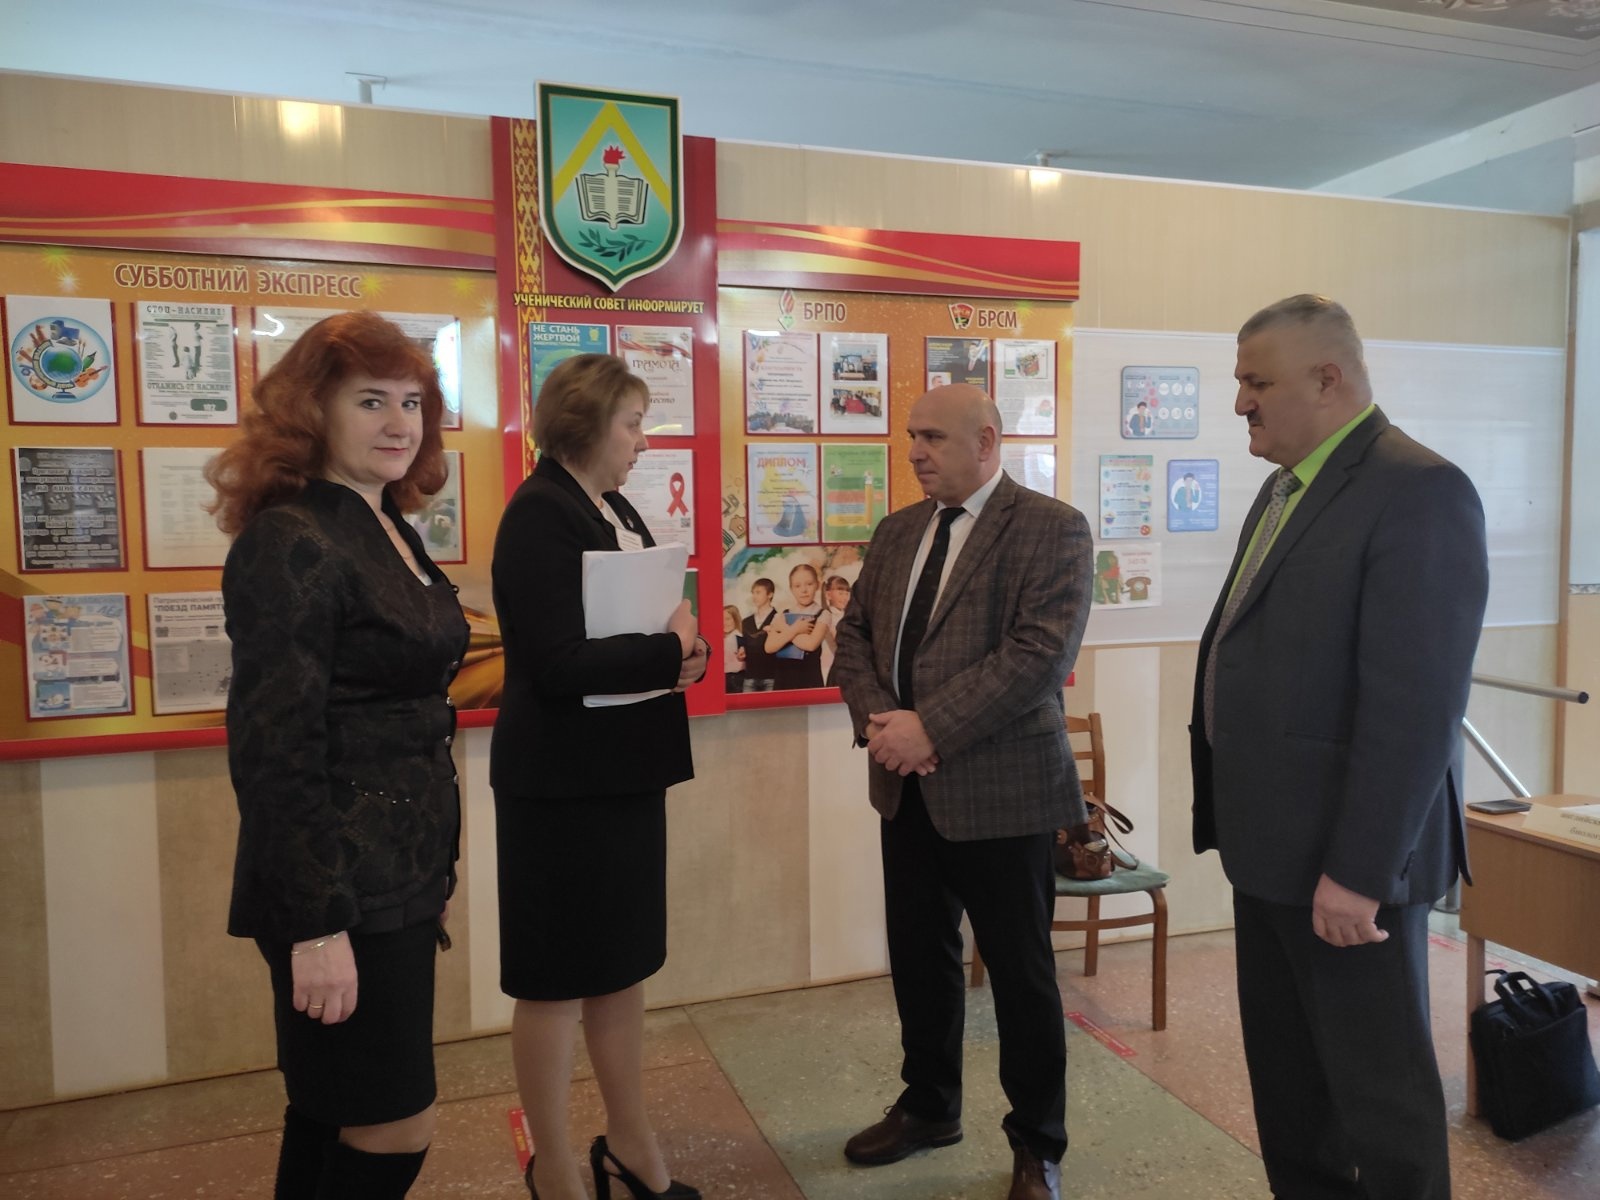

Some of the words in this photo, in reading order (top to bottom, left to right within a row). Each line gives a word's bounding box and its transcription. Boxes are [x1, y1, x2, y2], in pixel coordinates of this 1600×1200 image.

[115, 264, 249, 292] СУББОТНИЙ
[258, 271, 361, 297] ЭКСПРЕСС
[514, 293, 592, 309] УЧЕНИЧЕСКИЙ
[593, 298, 625, 311] СОВЕТ
[628, 300, 705, 314] ИНФОРМИРУЕТ
[804, 303, 846, 323] БРПО
[977, 310, 1017, 328] БРСМ
[533, 324, 546, 333] НЕ
[549, 326, 581, 335] СТАНЬ
[533, 333, 580, 343] ЖЕРТВОЙ
[757, 457, 806, 469] ДИПЛОМ
